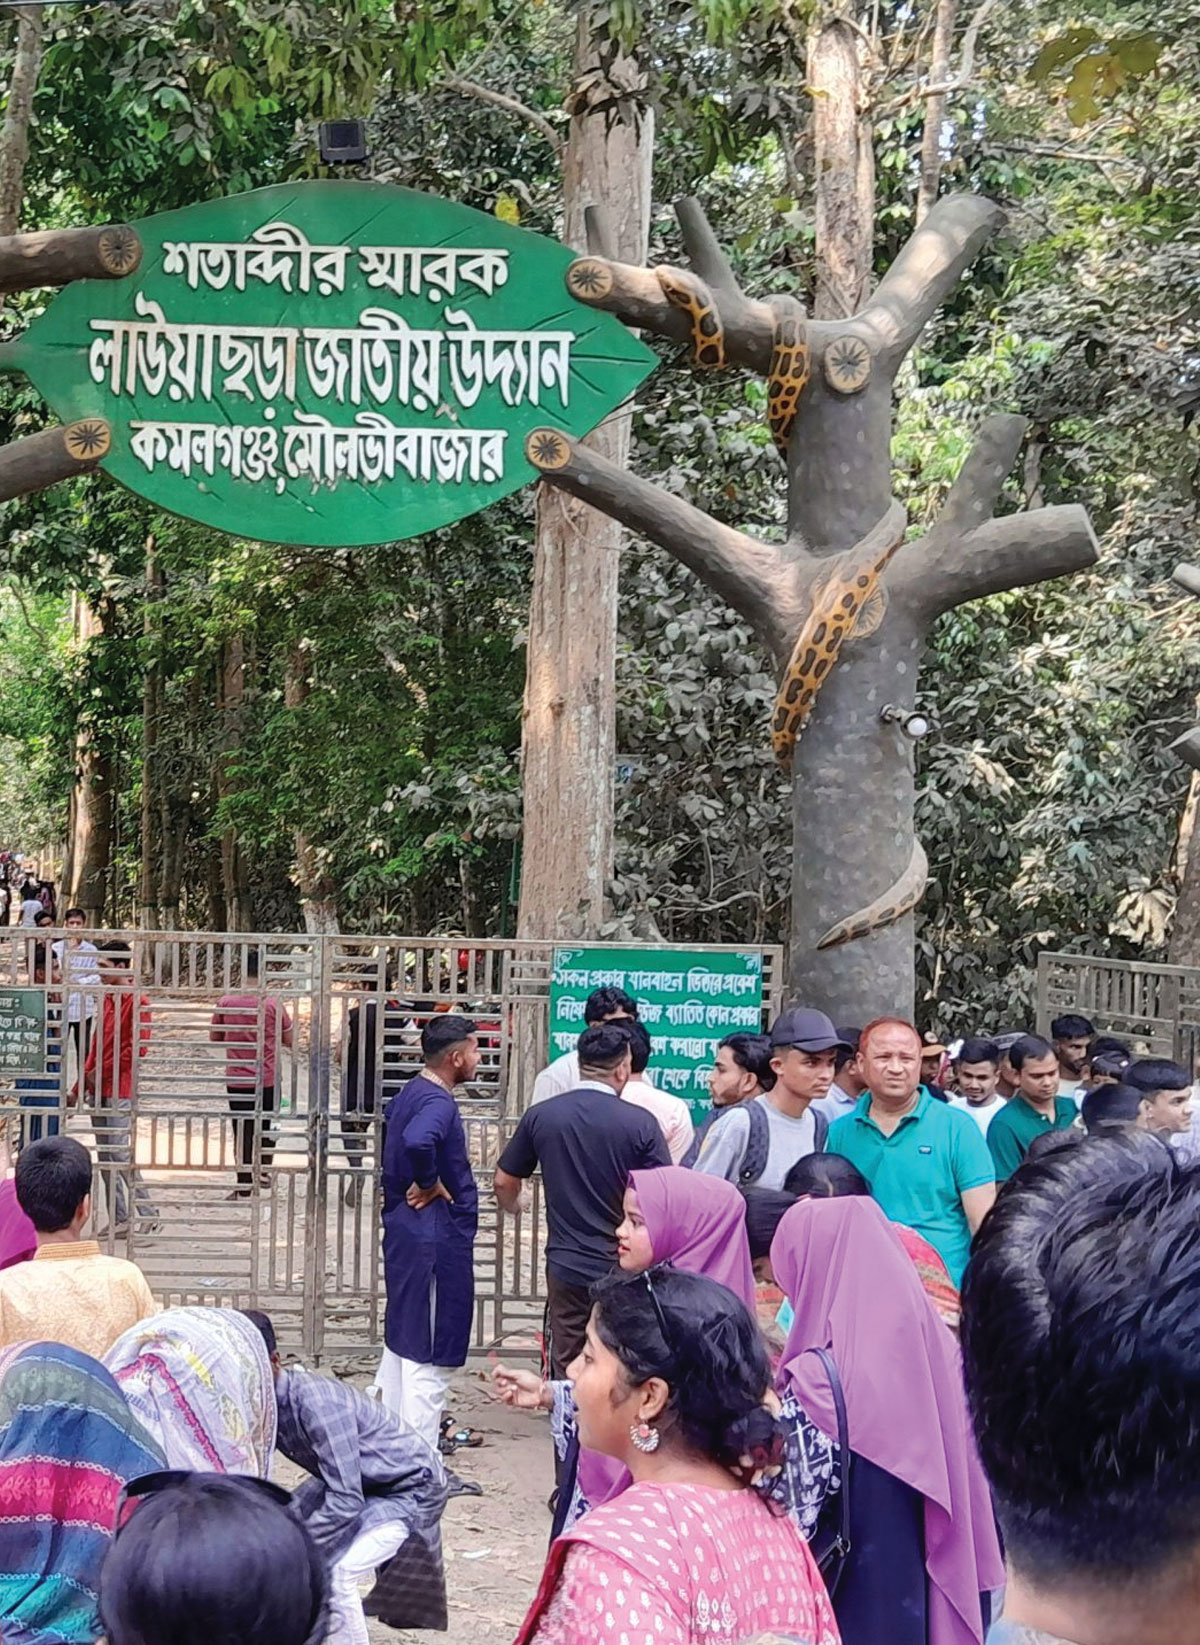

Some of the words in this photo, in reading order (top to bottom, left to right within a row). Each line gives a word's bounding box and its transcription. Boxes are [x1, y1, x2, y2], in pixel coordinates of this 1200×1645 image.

[162, 222, 351, 296] শতাব্দীর
[358, 246, 509, 302] স্মারক
[88, 292, 302, 419] লাউয়াছড়া
[302, 307, 445, 411] জাতীয়
[445, 307, 575, 407] উদ্যান
[628, 970, 684, 992] যানবাহন
